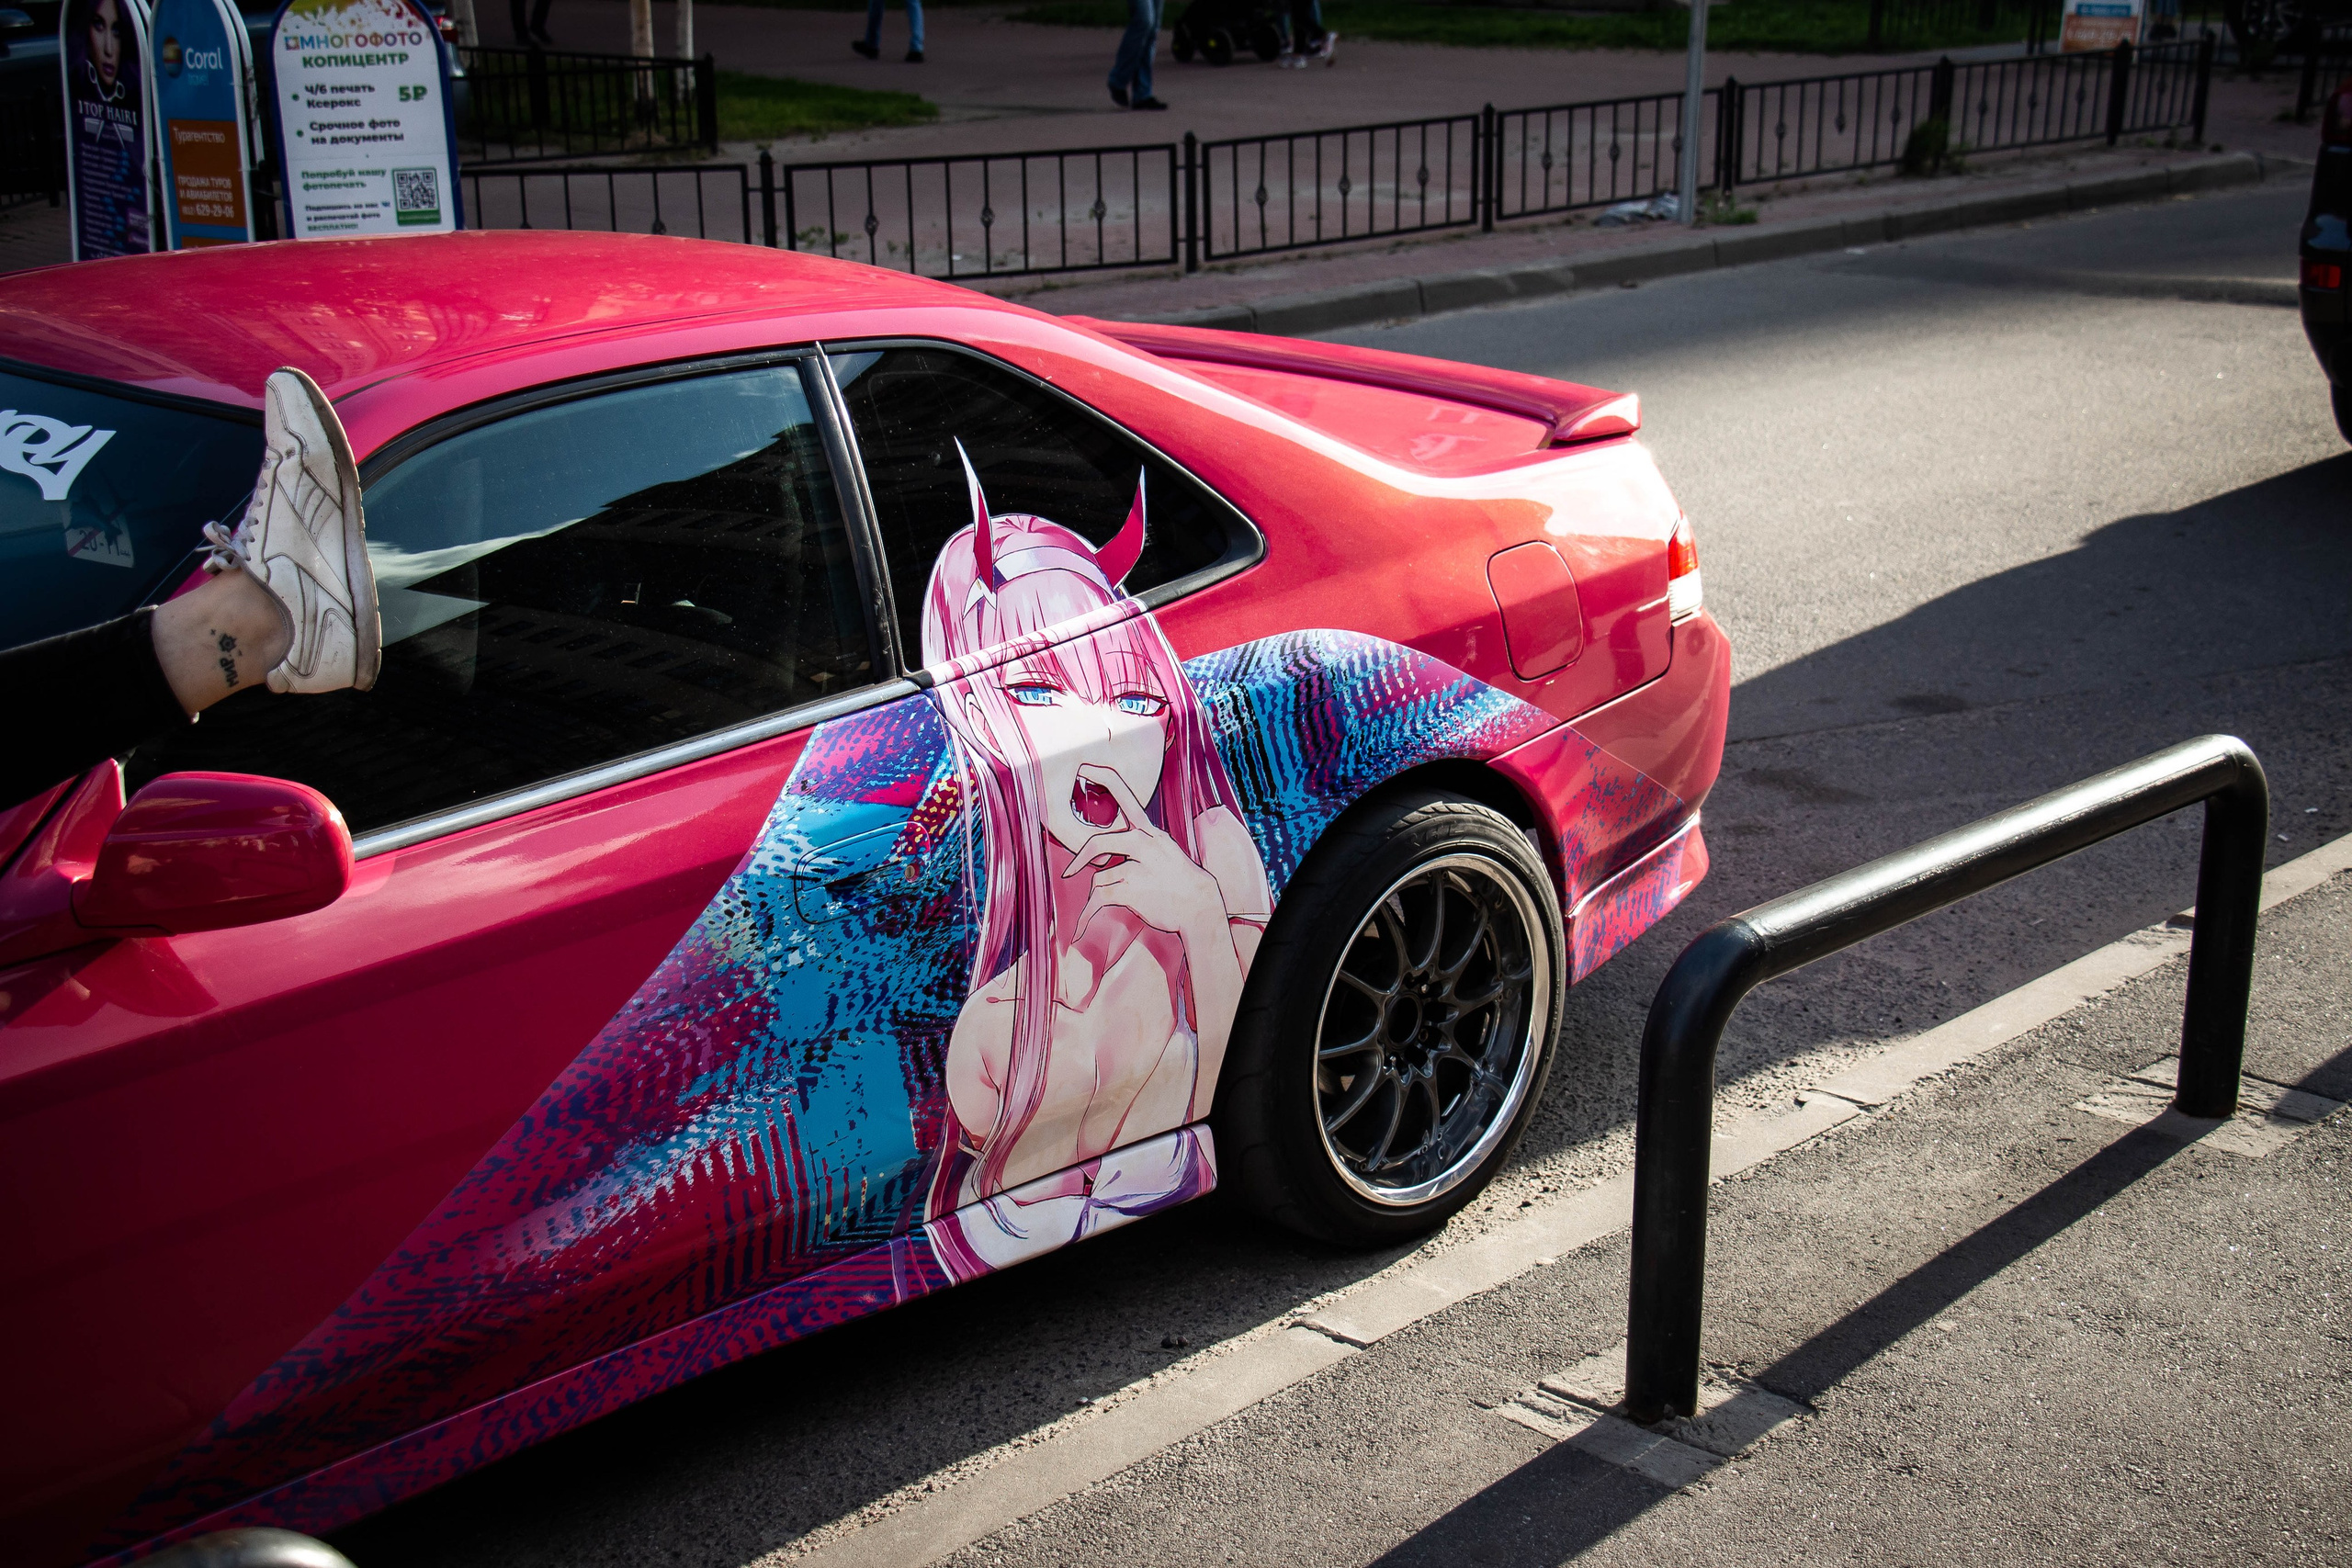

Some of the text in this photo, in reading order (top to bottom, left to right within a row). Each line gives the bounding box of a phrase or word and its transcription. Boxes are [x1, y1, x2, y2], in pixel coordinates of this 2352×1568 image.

[300, 31, 423, 50] МНОГОФОТО
[185, 47, 223, 70] Coral
[302, 51, 410, 69] КОПИЦЕНТР
[330, 84, 376, 95] печать
[306, 97, 362, 110] Ксерокс
[310, 118, 401, 133] Срочное фото
[173, 126, 226, 145] Турагентство
[311, 132, 404, 146] на документы
[301, 168, 387, 181] Попробуй нашу
[302, 181, 367, 192] фотопечать
